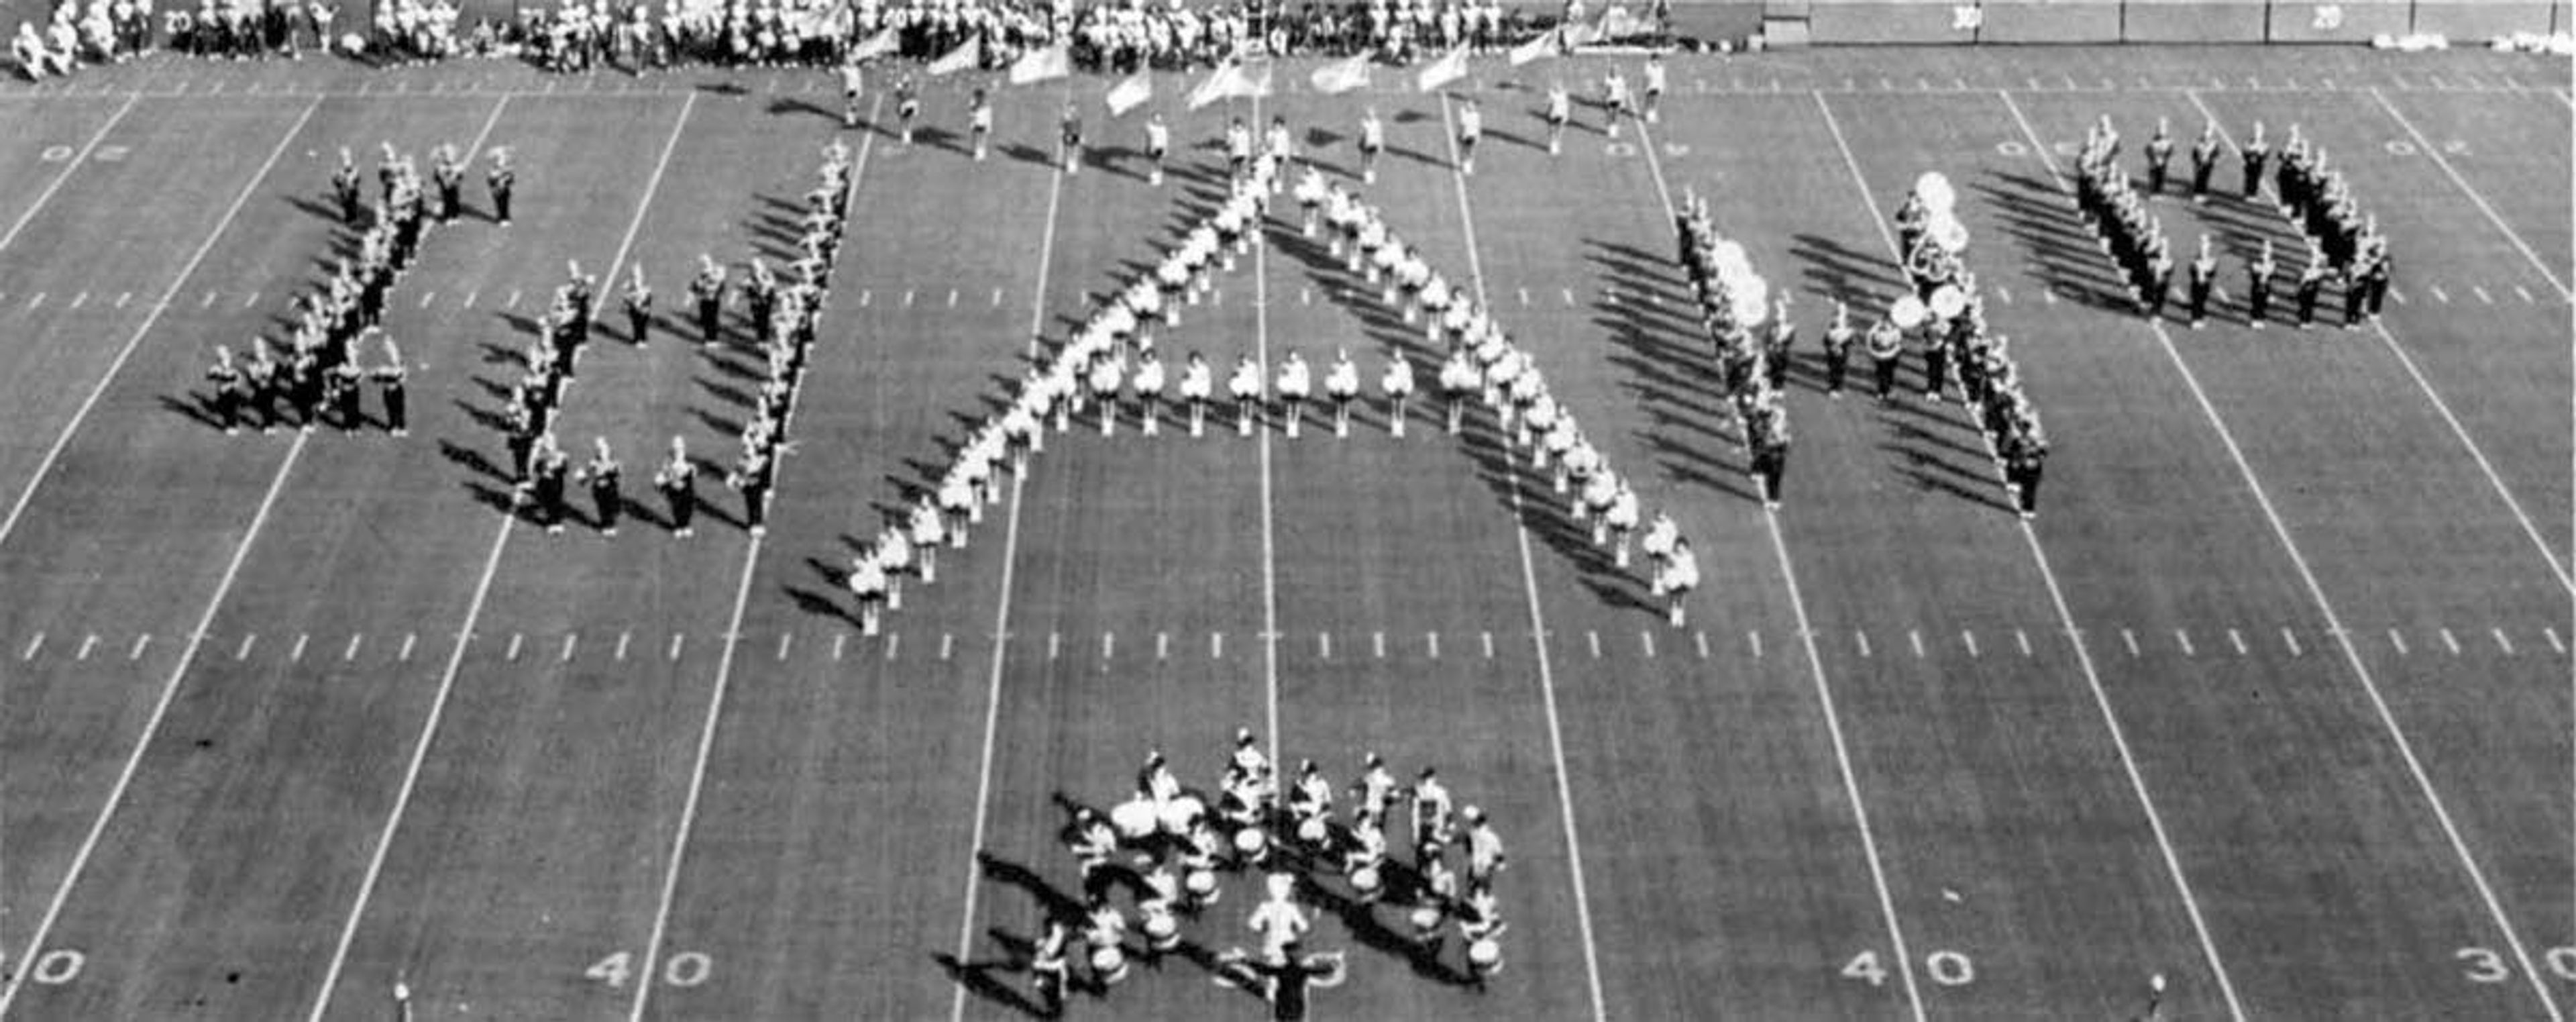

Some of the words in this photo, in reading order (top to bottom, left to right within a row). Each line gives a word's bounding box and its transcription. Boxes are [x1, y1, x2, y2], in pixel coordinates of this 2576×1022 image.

[585, 952, 712, 987] 40
[1841, 950, 1974, 985] 40
[2456, 948, 2575, 982] 30
